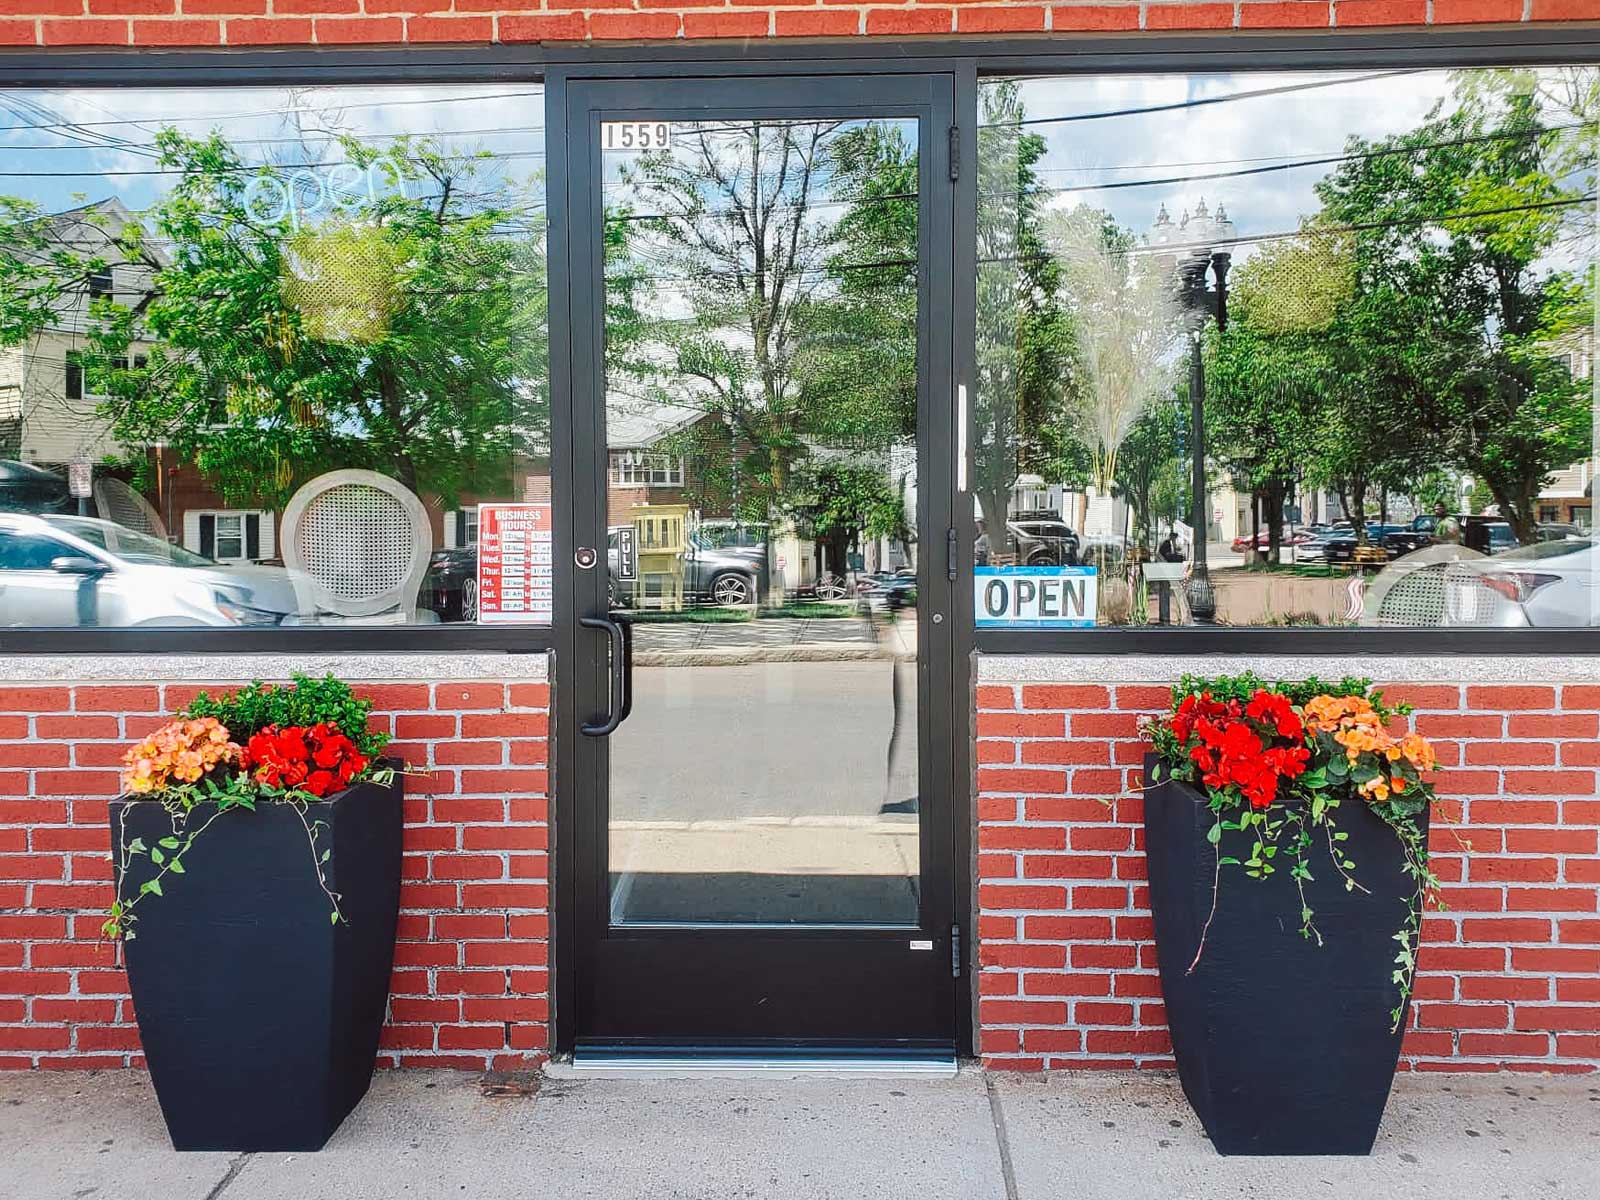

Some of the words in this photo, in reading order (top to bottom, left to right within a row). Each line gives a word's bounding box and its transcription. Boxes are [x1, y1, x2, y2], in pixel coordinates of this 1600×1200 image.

[608, 124, 667, 147] 1559
[243, 157, 407, 233] open
[495, 511, 541, 520] BUSINESS
[502, 521, 536, 530] HOURS:
[622, 531, 631, 576] PULL
[482, 567, 500, 575] Thur.
[482, 578, 495, 586] Fri.
[482, 590, 496, 598] Sat.
[984, 579, 1085, 617] OPEN
[482, 601, 498, 610] Sun.
